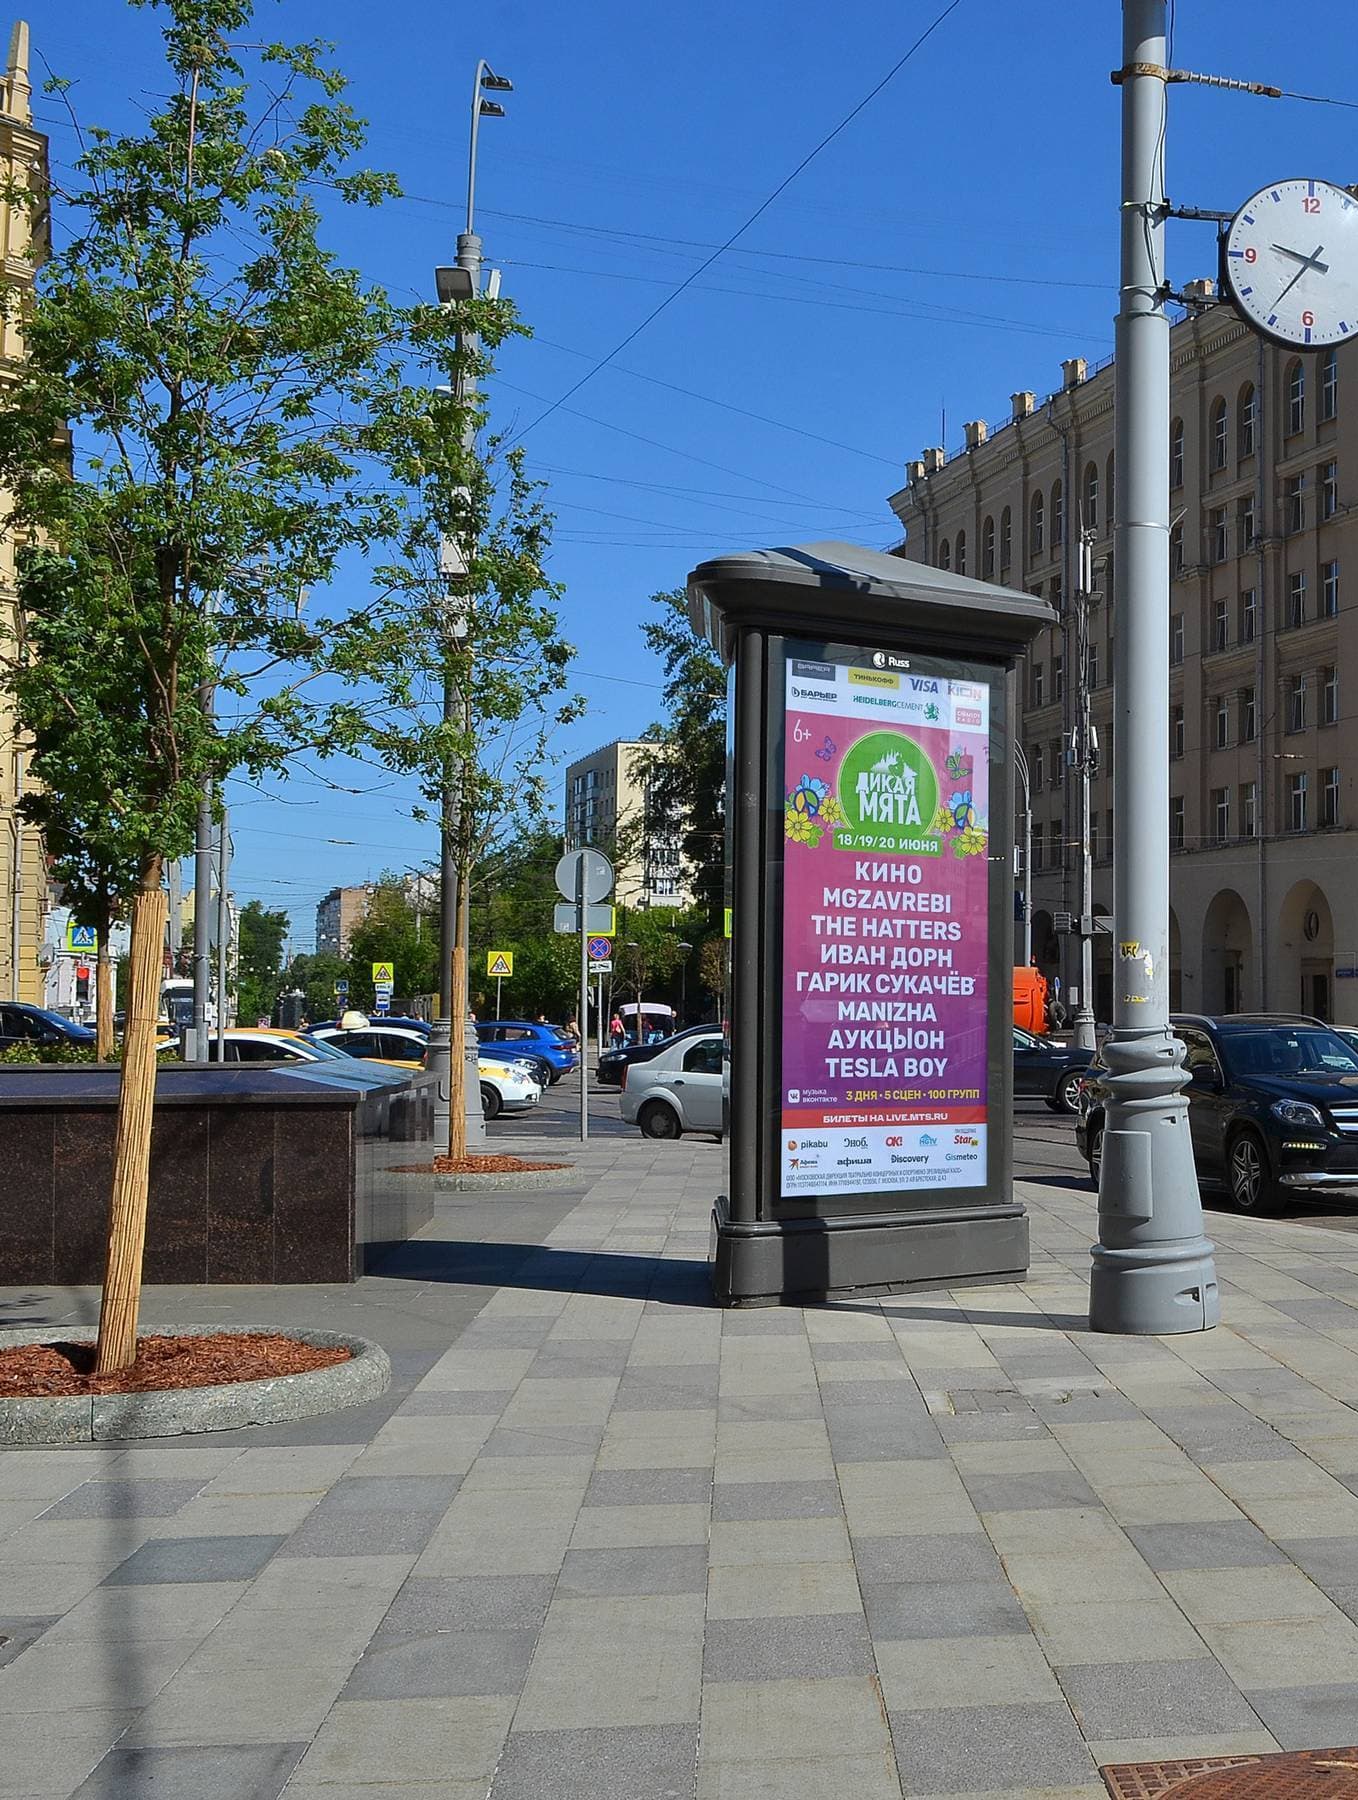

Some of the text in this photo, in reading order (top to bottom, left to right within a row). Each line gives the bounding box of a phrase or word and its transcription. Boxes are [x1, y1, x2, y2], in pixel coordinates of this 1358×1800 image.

[1301, 198, 1321, 214] 12
[1244, 248, 1257, 264] 9
[1302, 311, 1314, 326] 6
[888, 656, 910, 668] Russ
[854, 673, 894, 685] ТИНЬКОФФ
[909, 677, 939, 694] VISA
[801, 689, 838, 700] БАРЬЕР
[853, 695, 923, 711] HEIDELBERGCEMENT
[793, 719, 812, 743] 6+
[856, 772, 916, 795] ДИКАЯ
[859, 791, 922, 826] МЯТА
[837, 834, 938, 852] 18/19/20 ИЮНЯ
[855, 861, 922, 884] КИНО
[823, 887, 951, 913] MGZAVREBI
[811, 915, 962, 941] THE HATTERS
[821, 944, 952, 970] ИВАН ДОРН
[796, 971, 975, 996] ГАРИК СУКАЧЁВ
[838, 1001, 937, 1023] MANIZHA
[827, 1027, 944, 1052] АУКЦЫОН
[824, 1058, 948, 1078] TESLA BOY
[802, 1088, 827, 1097] музыка
[846, 1090, 877, 1102] 3 ДНЯ
[884, 1090, 921, 1101] 5 СЦЕН
[927, 1089, 980, 1099] 100 ГРУПП
[823, 1113, 948, 1123] БИЛЕТЫ НА LIVE.MTS.RU
[801, 1140, 828, 1150] pikabu
[837, 1157, 872, 1167] афиша
[891, 1154, 929, 1164] Discovery
[945, 1153, 978, 1161] Gismeteo
